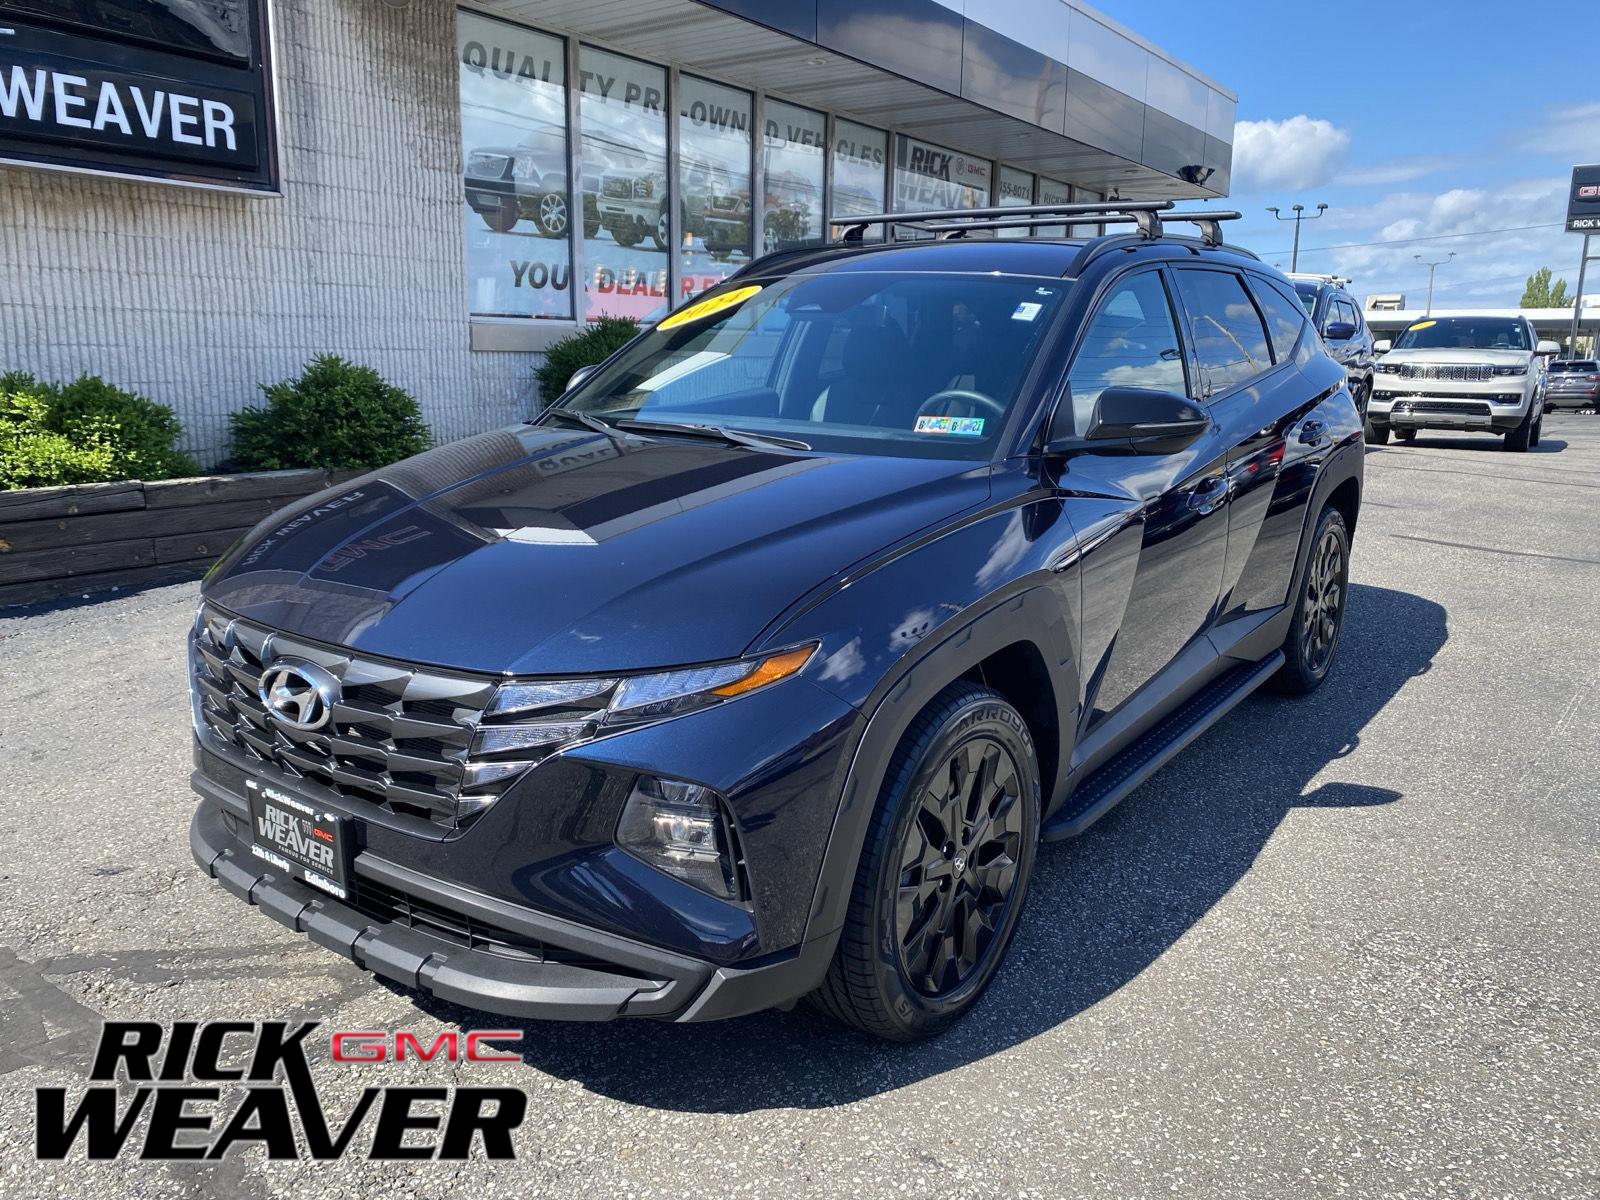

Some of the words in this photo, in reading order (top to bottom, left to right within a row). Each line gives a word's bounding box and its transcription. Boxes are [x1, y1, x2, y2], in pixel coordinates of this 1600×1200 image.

[0, 65, 238, 151] WEAVER
[910, 146, 952, 181] RICK
[967, 165, 985, 177] GMC
[1573, 219, 1594, 228] RICK
[265, 804, 299, 831] RICK
[313, 828, 334, 842] GMC
[258, 816, 334, 869] WEAVER
[278, 845, 299, 859] FAMOUS
[299, 855, 310, 864] FOR
[311, 859, 334, 875] SERVICE
